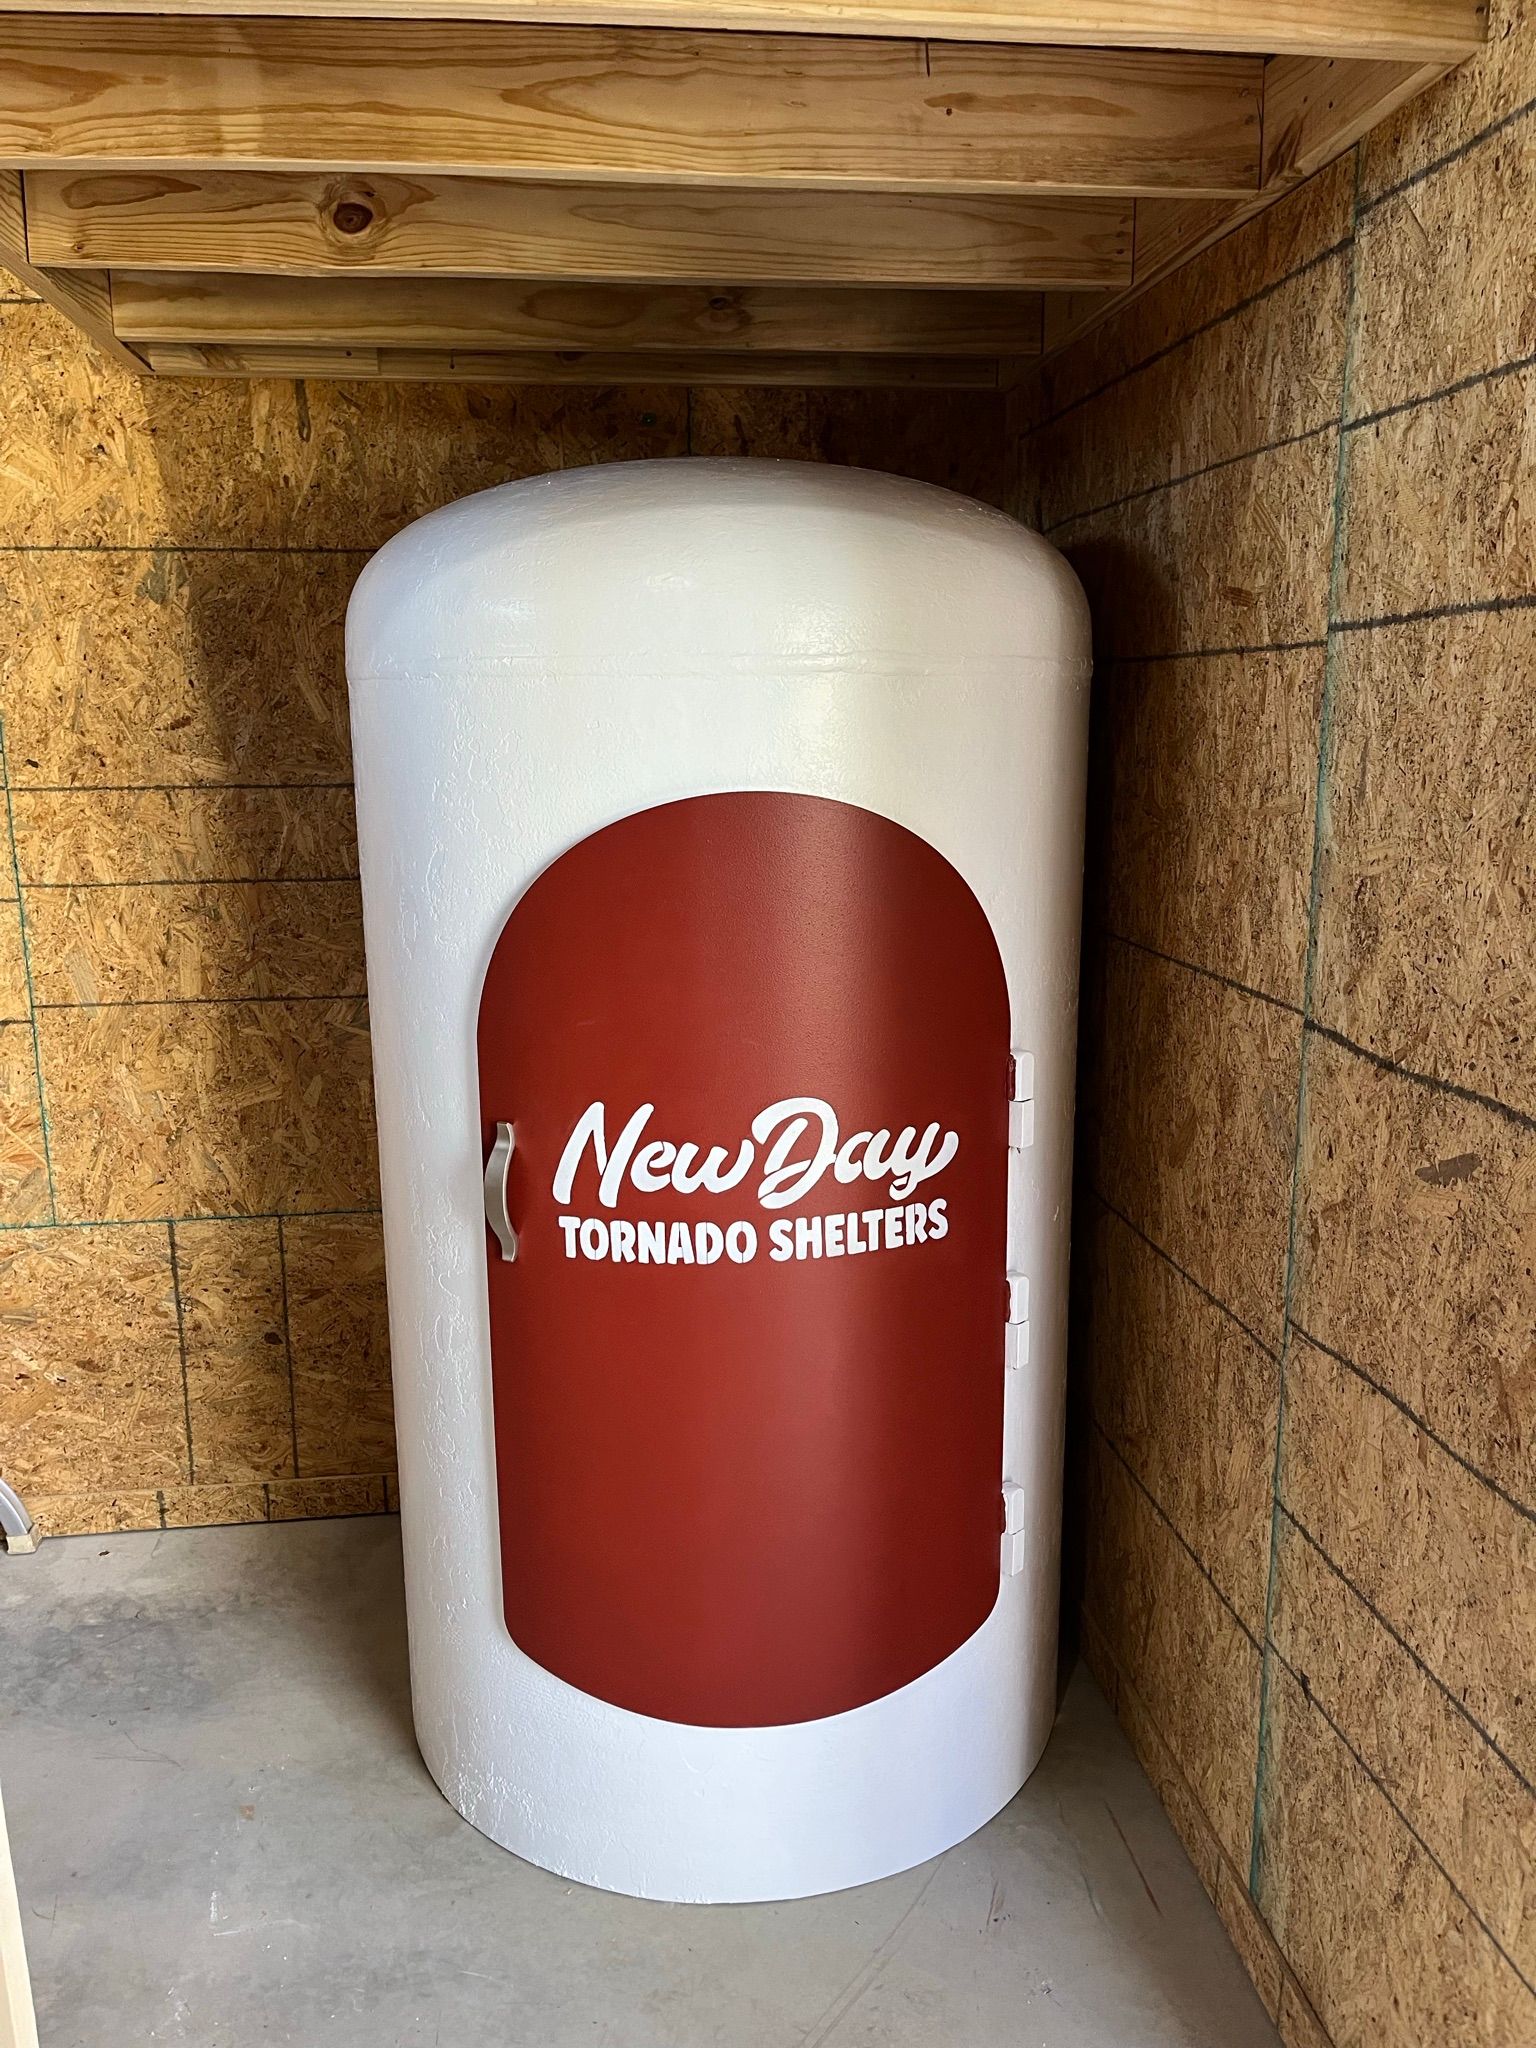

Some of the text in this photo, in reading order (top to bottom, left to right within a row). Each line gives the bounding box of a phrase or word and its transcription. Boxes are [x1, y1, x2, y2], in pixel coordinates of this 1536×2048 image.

[552, 1096, 959, 1210] New Day
[558, 1198, 949, 1265] TORNADO SHELTERS
